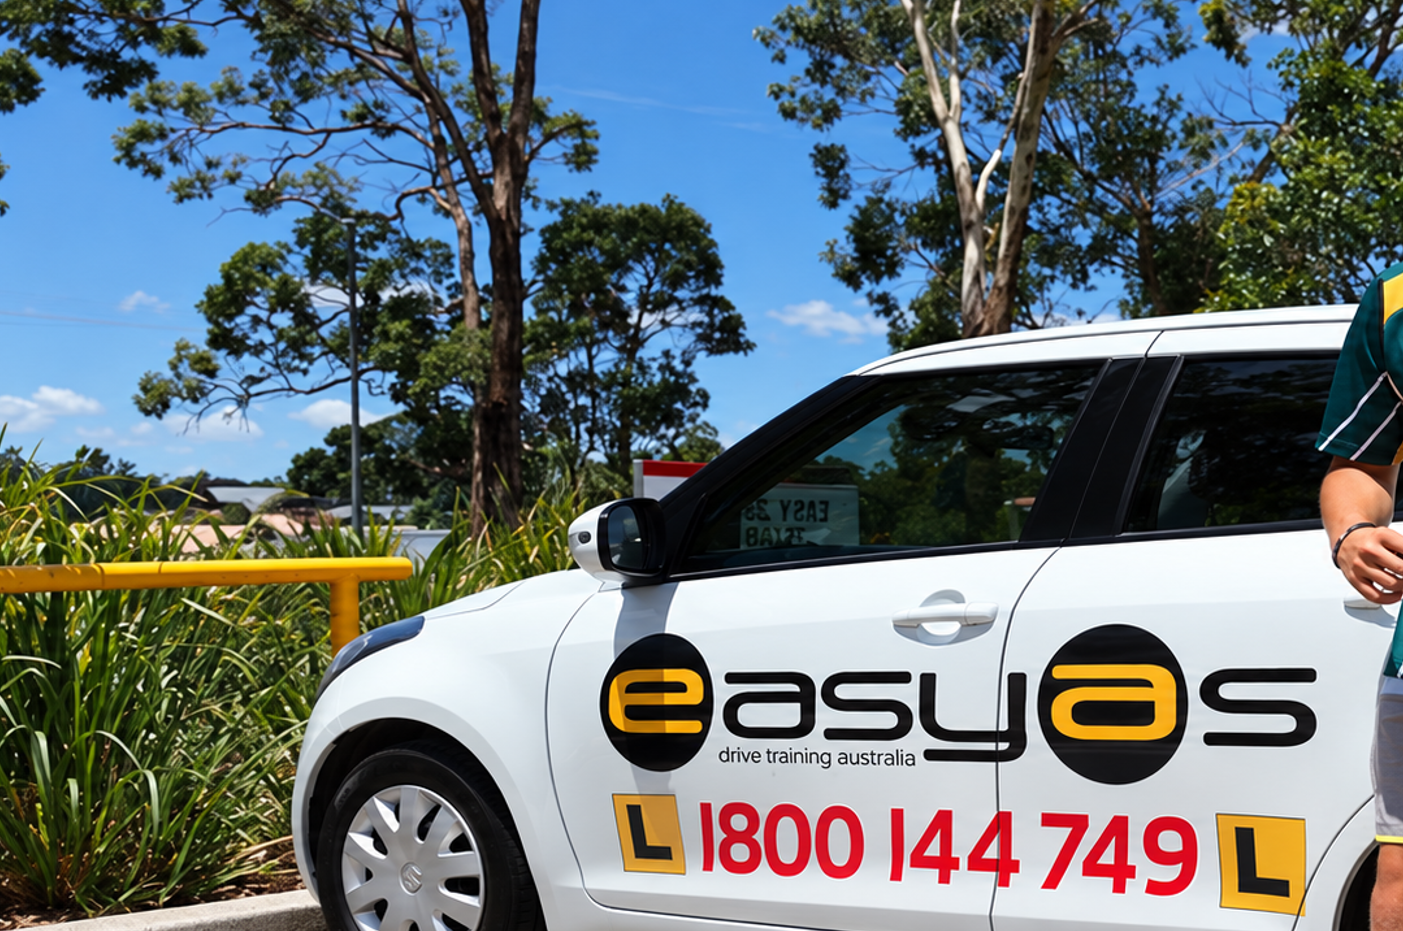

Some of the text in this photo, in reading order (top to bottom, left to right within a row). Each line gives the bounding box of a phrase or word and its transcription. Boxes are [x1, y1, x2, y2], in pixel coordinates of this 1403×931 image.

[607, 663, 1318, 763] easyas
[718, 747, 916, 769] drive training australia
[626, 804, 673, 861] L
[699, 801, 1198, 897] 1800 144 749
[1234, 826, 1290, 898] L
